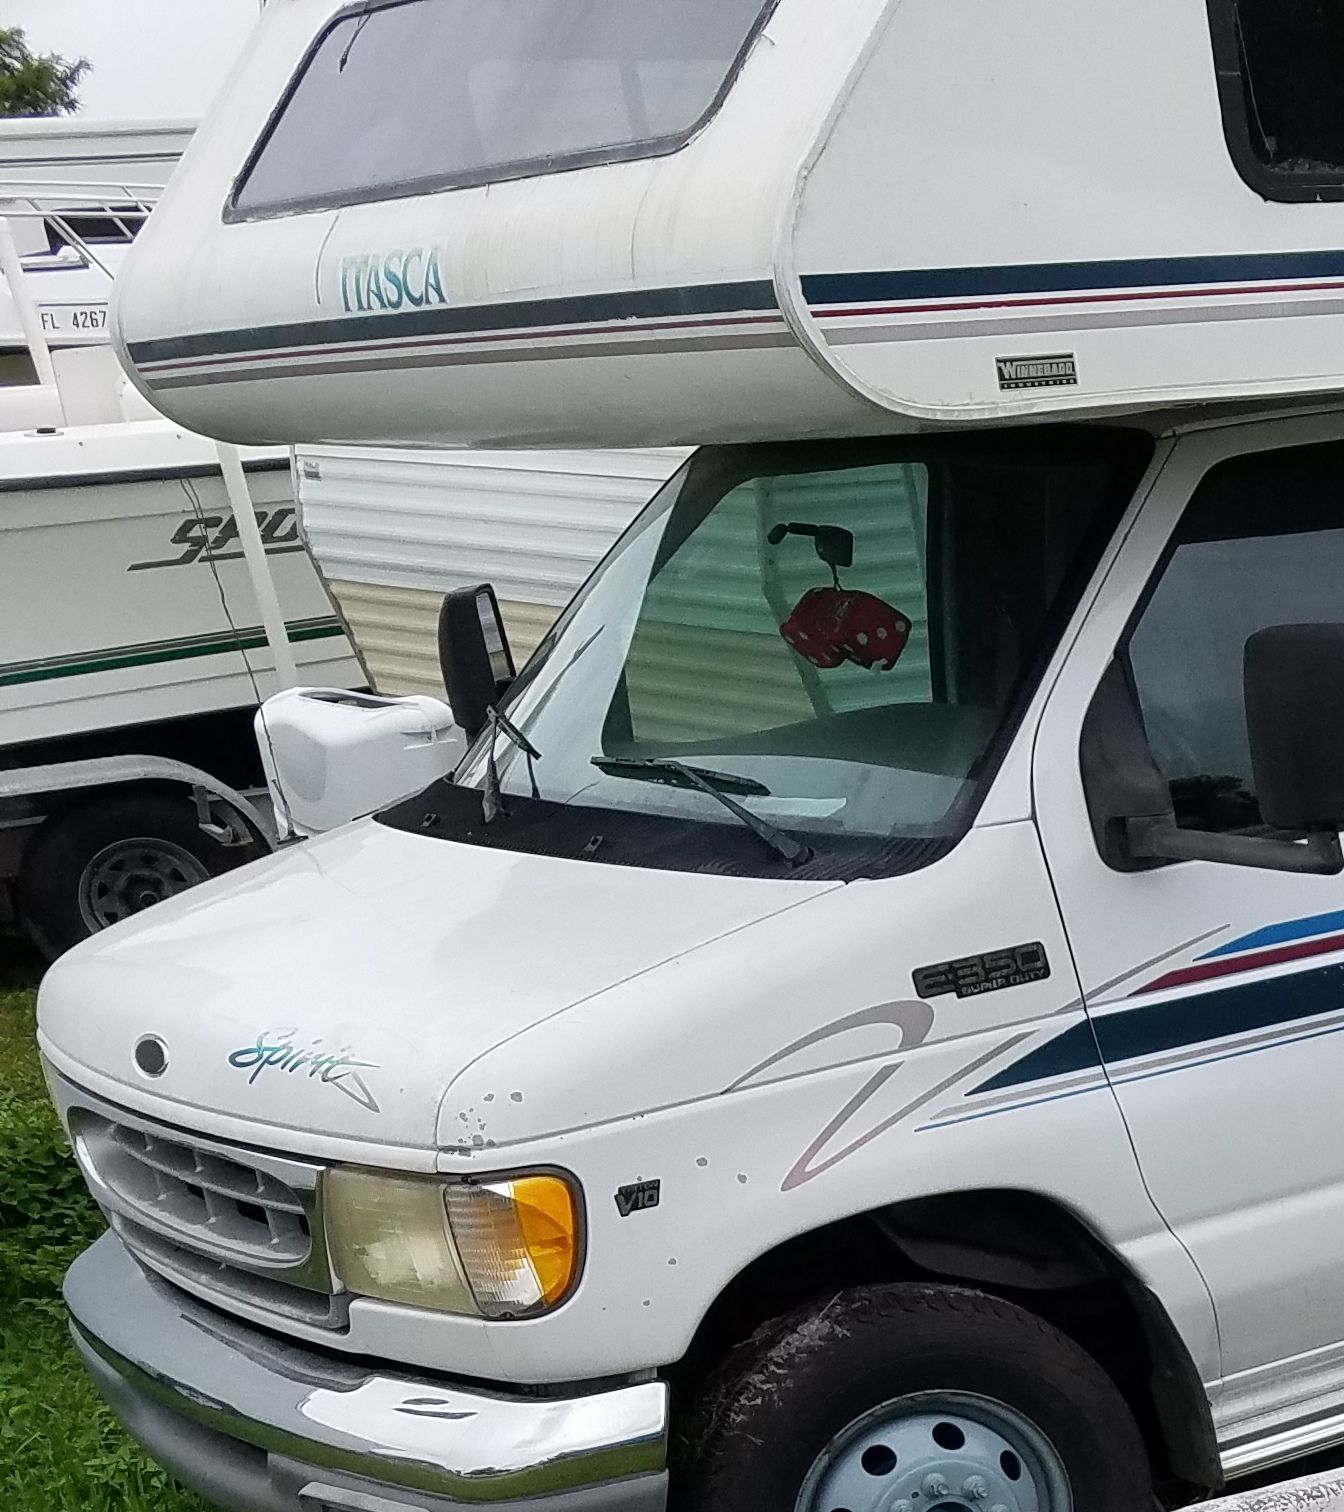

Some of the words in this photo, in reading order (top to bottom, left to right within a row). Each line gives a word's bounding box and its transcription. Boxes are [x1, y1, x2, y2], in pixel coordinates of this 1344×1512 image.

[341, 247, 448, 312] ITASCA
[41, 312, 60, 330] FL
[72, 310, 107, 329] 4267
[228, 1027, 382, 1086] Spirit
[617, 1190, 658, 1215] V10
